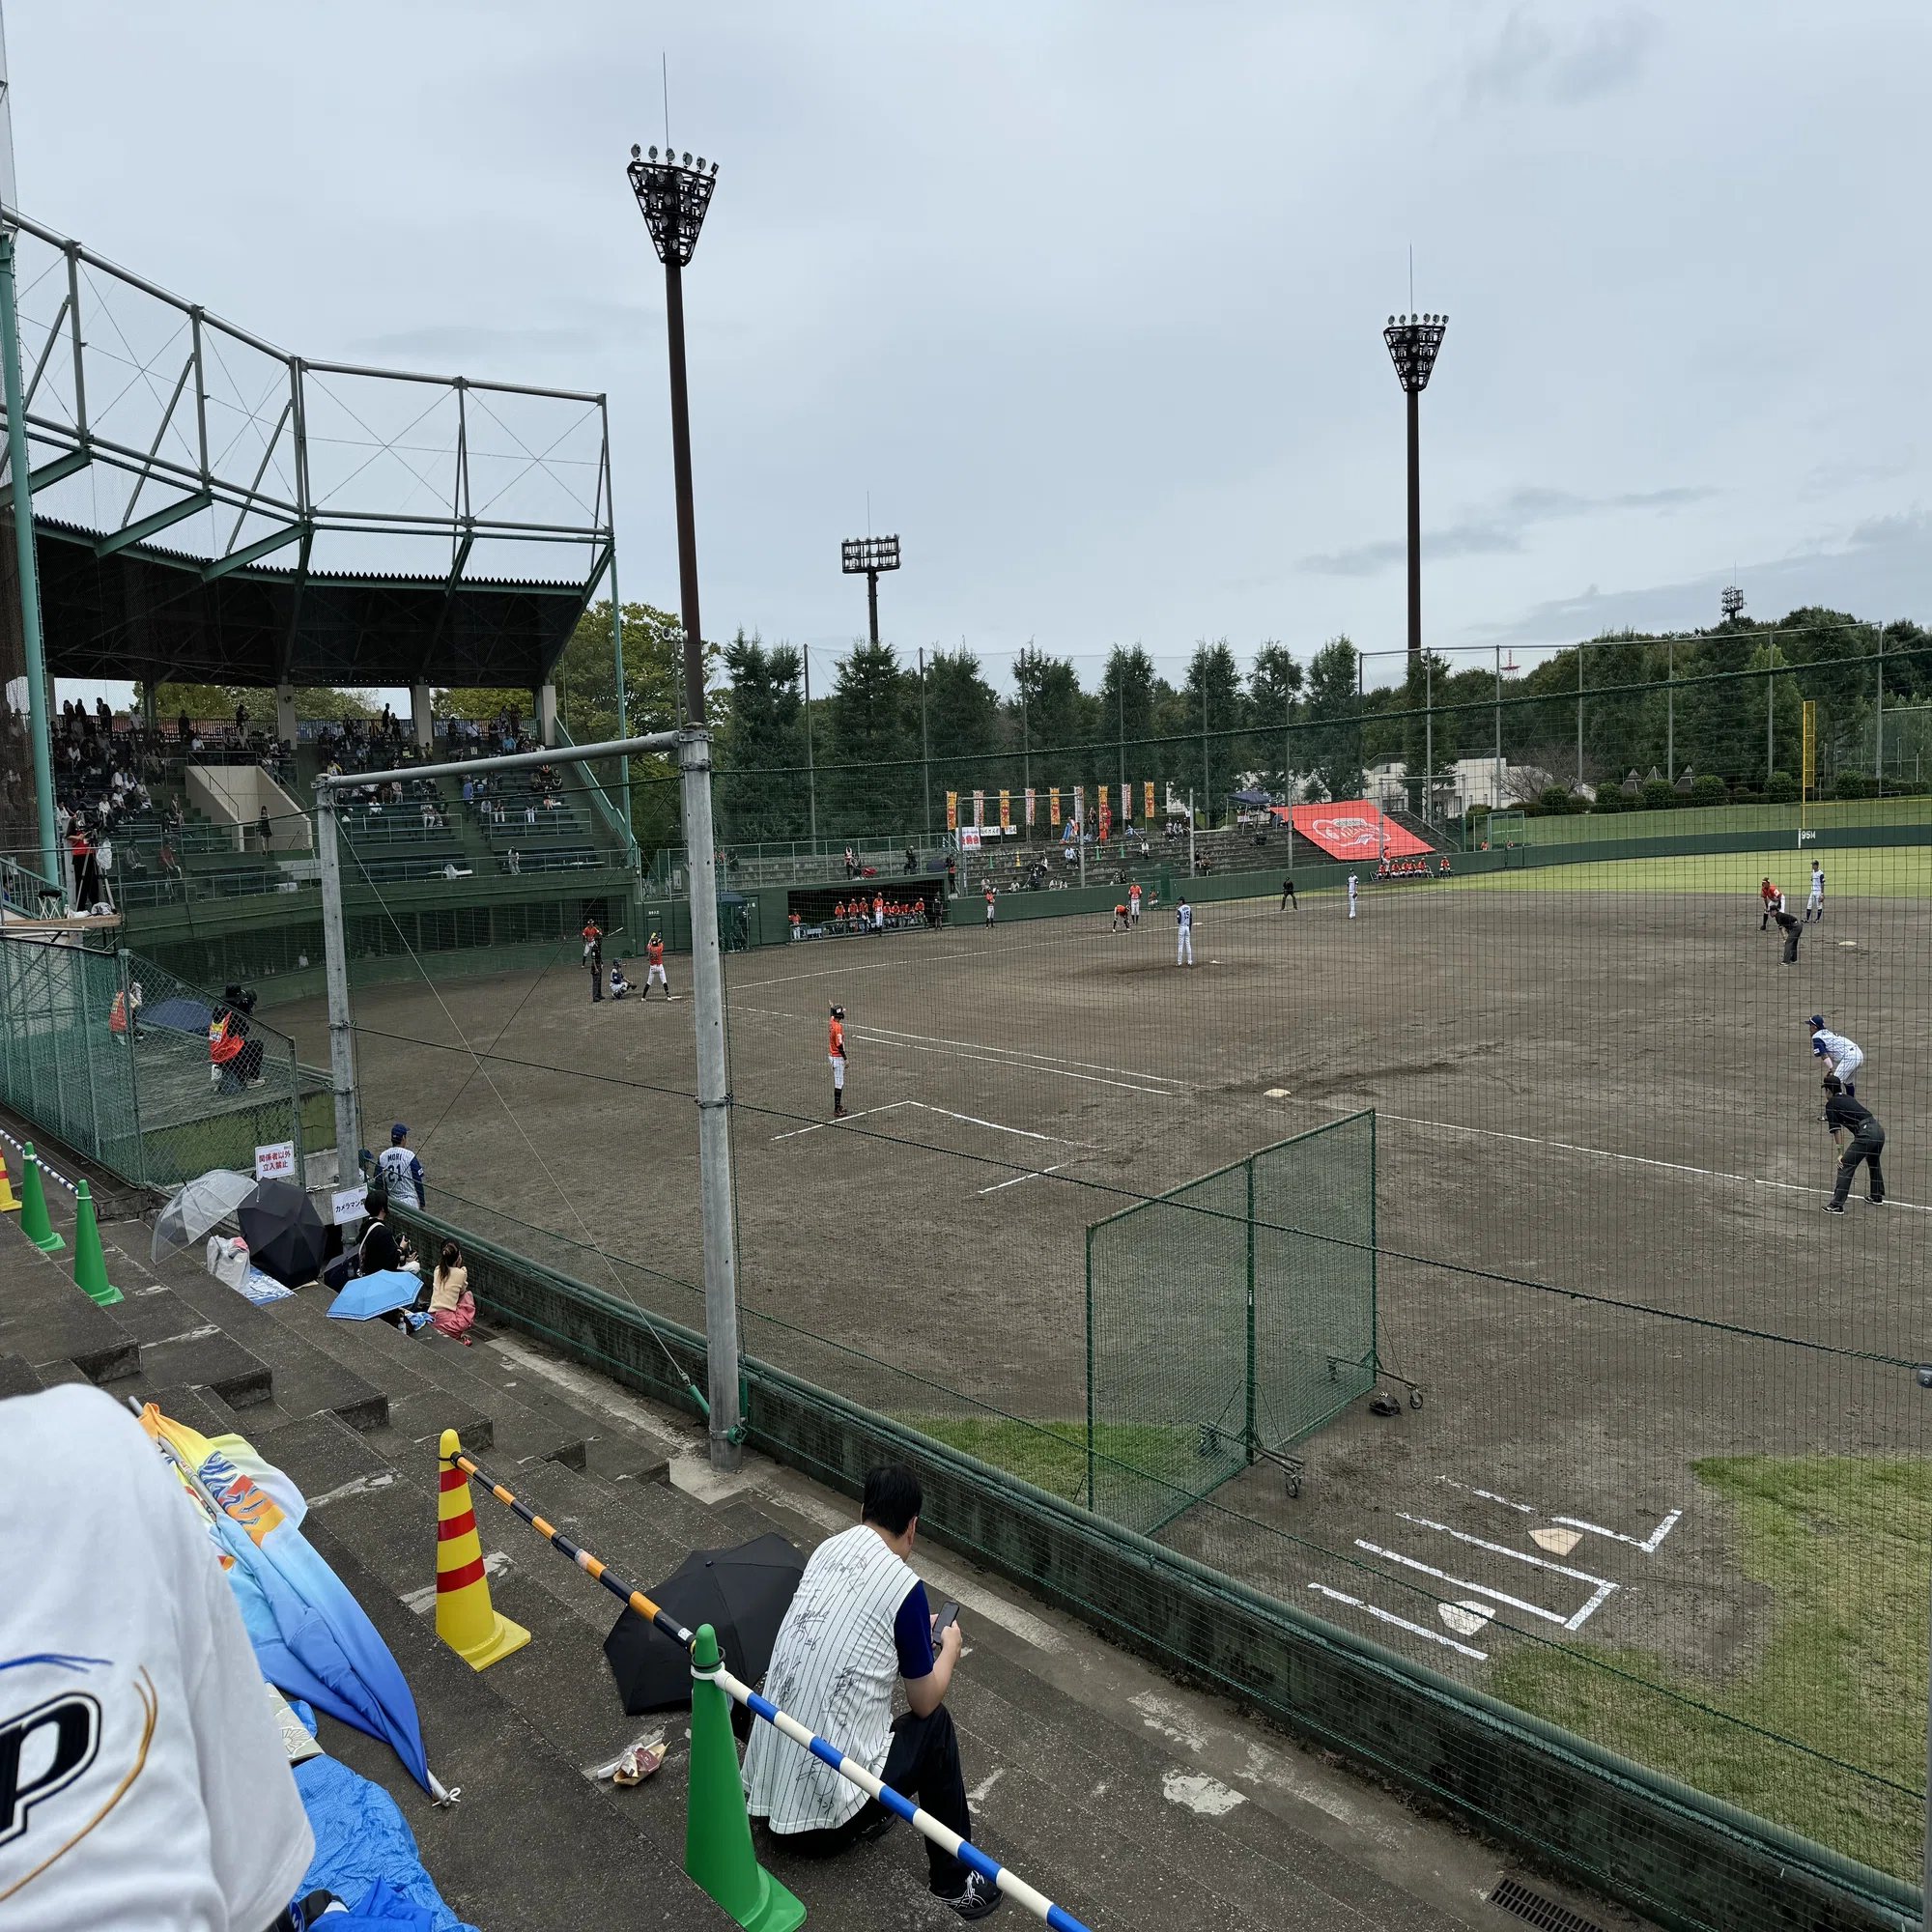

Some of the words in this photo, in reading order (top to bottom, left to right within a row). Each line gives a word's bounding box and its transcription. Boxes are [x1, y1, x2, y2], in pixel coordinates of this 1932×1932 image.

[259, 1151, 291, 1163] 関係者以外
[387, 1152, 403, 1161] MORI
[263, 1161, 289, 1172] 立入禁止
[387, 1164, 403, 1182] 21
